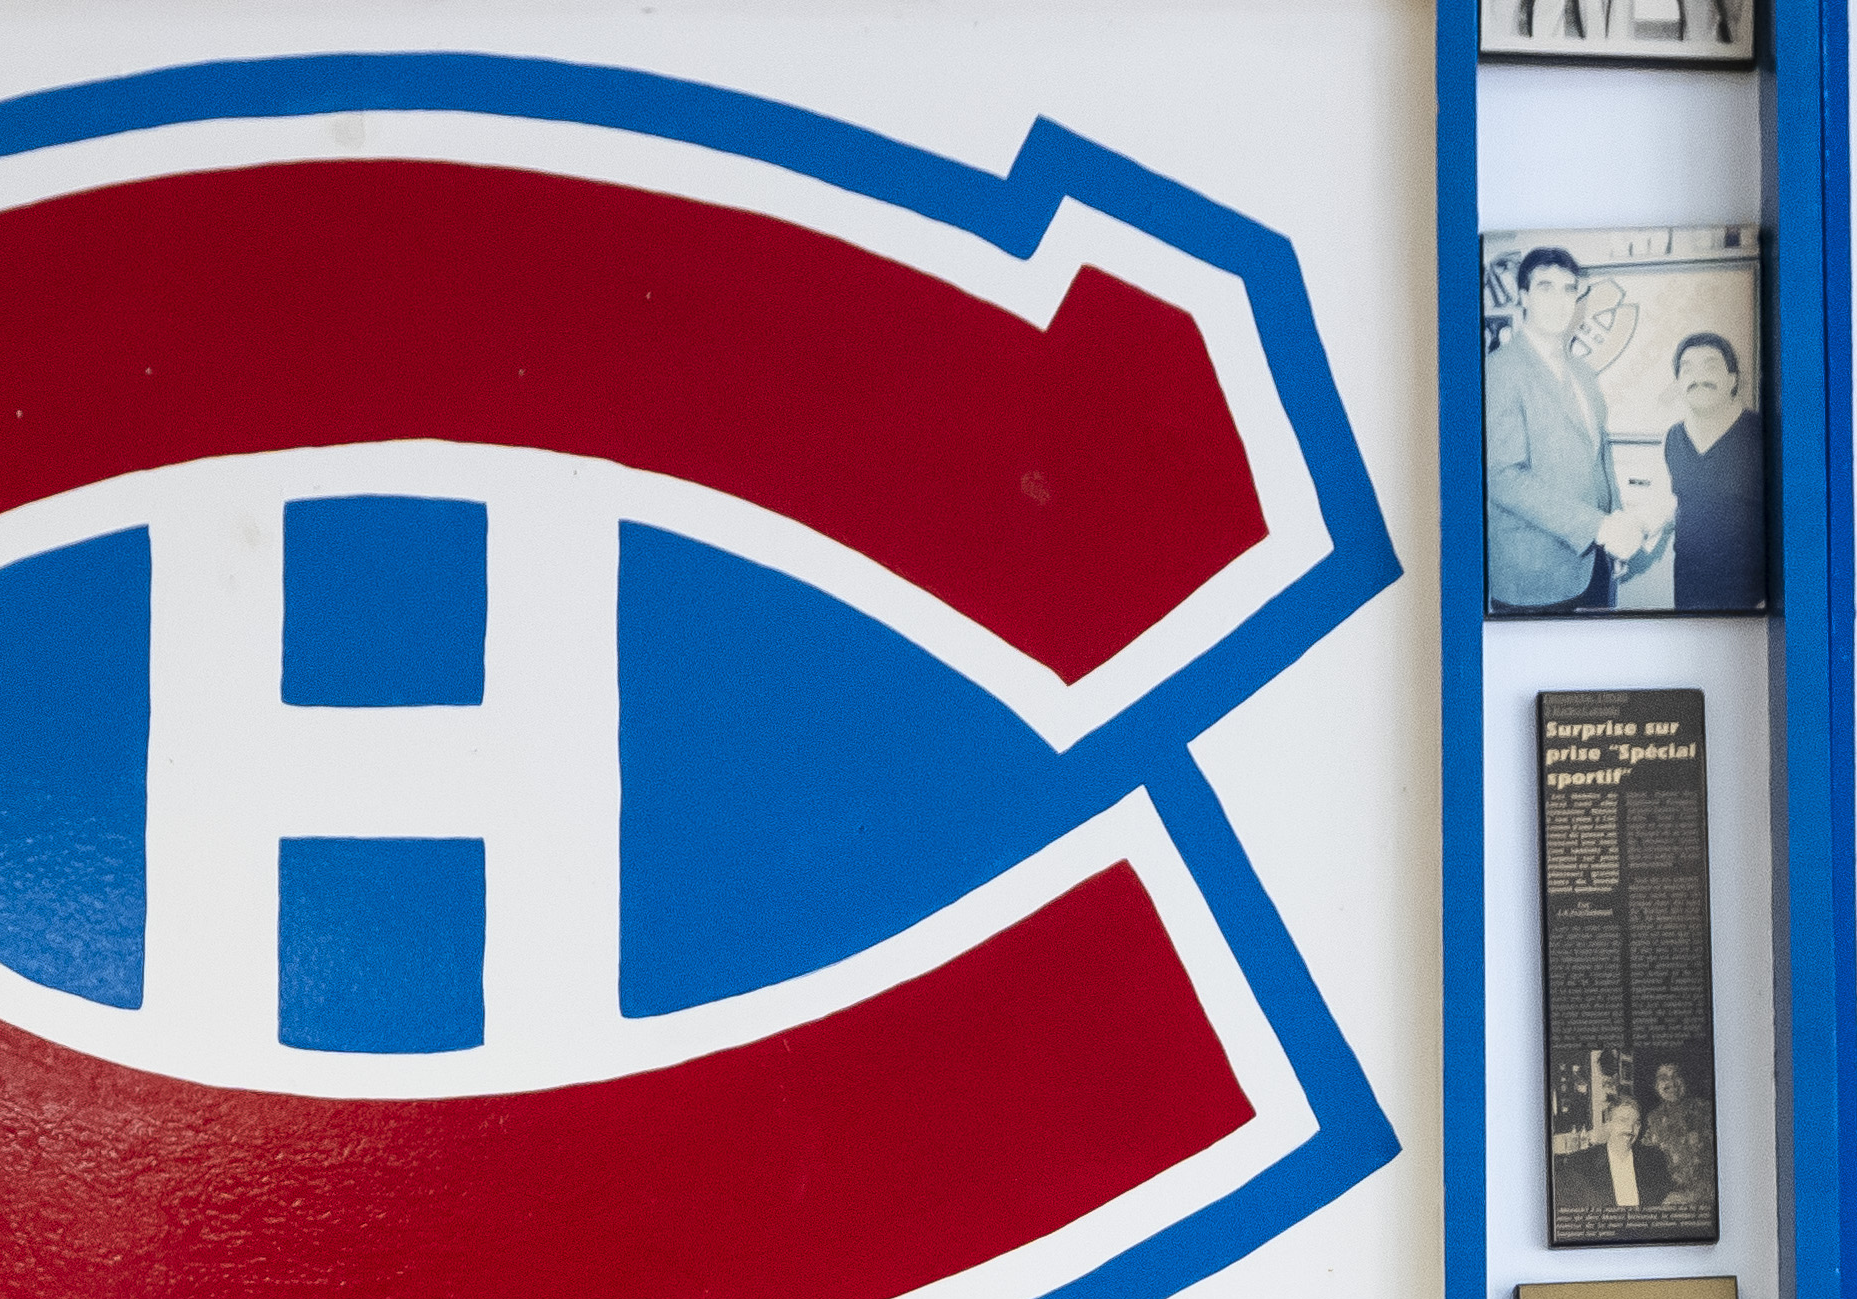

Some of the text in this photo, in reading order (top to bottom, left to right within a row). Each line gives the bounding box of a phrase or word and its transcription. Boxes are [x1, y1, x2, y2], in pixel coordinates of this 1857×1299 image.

[1546, 721, 1680, 740] Surprise sur
[1545, 745, 1601, 766] prise
